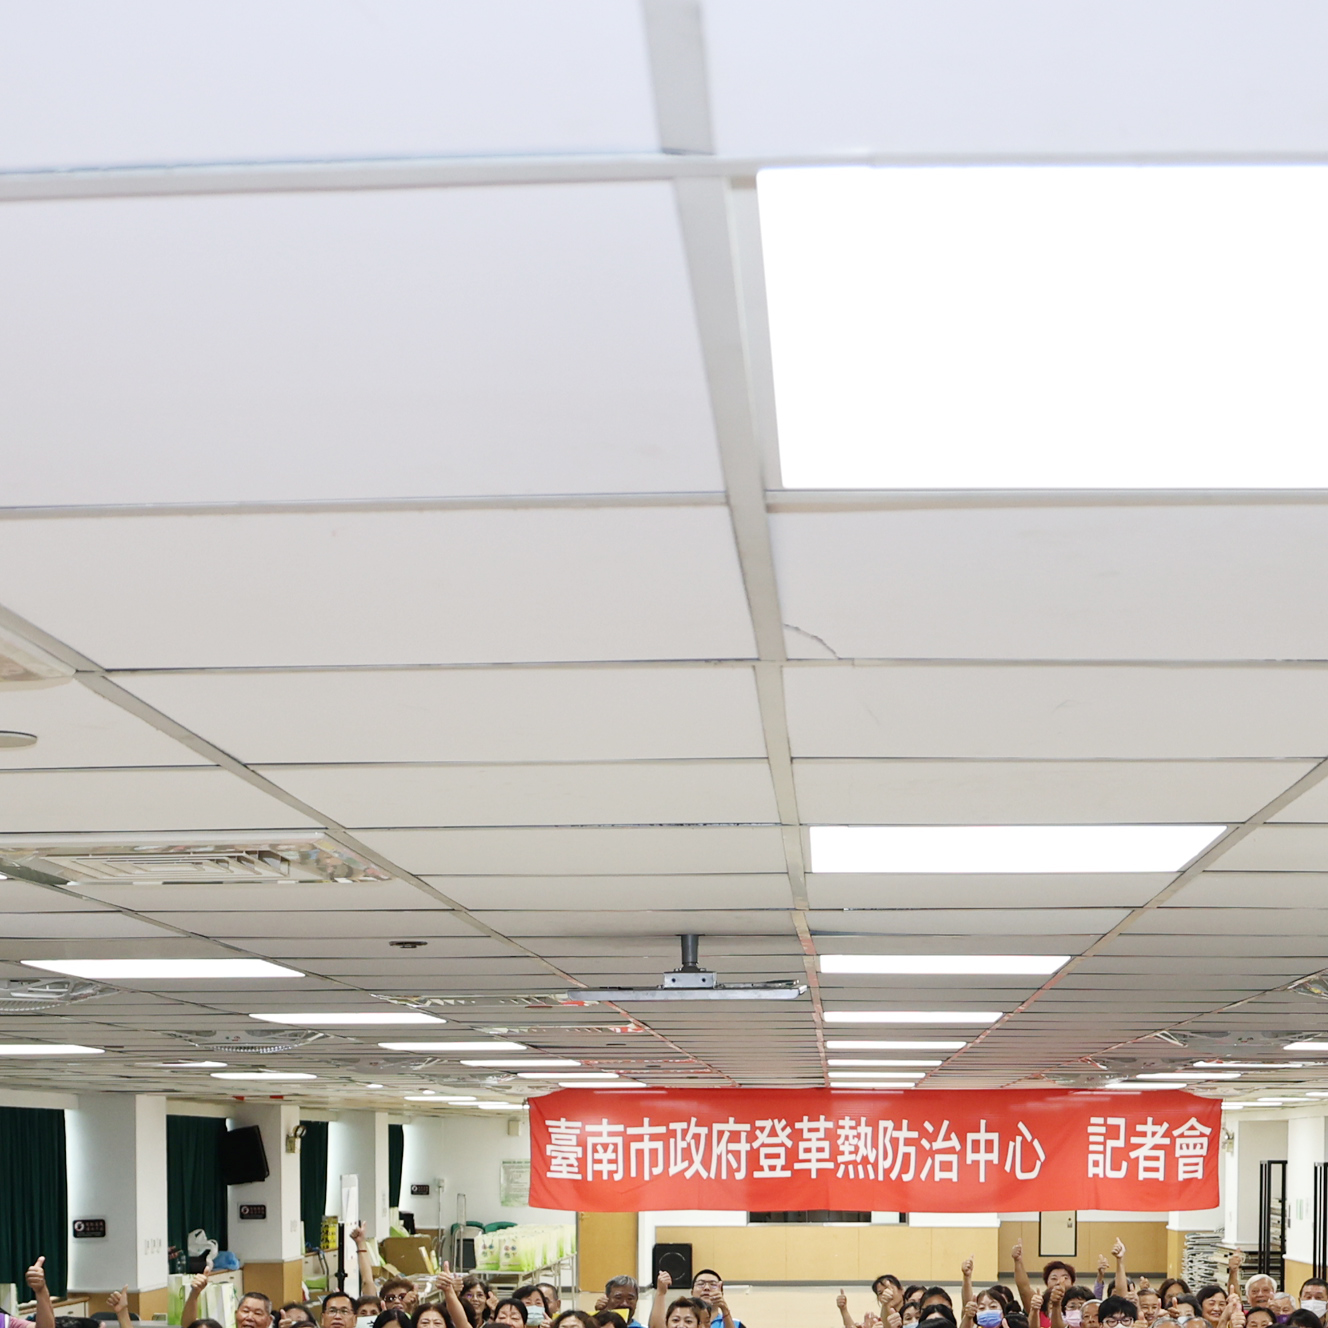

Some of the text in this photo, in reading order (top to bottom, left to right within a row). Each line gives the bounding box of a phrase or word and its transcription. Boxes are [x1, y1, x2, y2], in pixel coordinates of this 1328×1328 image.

[545, 1116, 1045, 1183] 臺南市政府登革熱防治中心
[1087, 1116, 1210, 1182] 記者會
